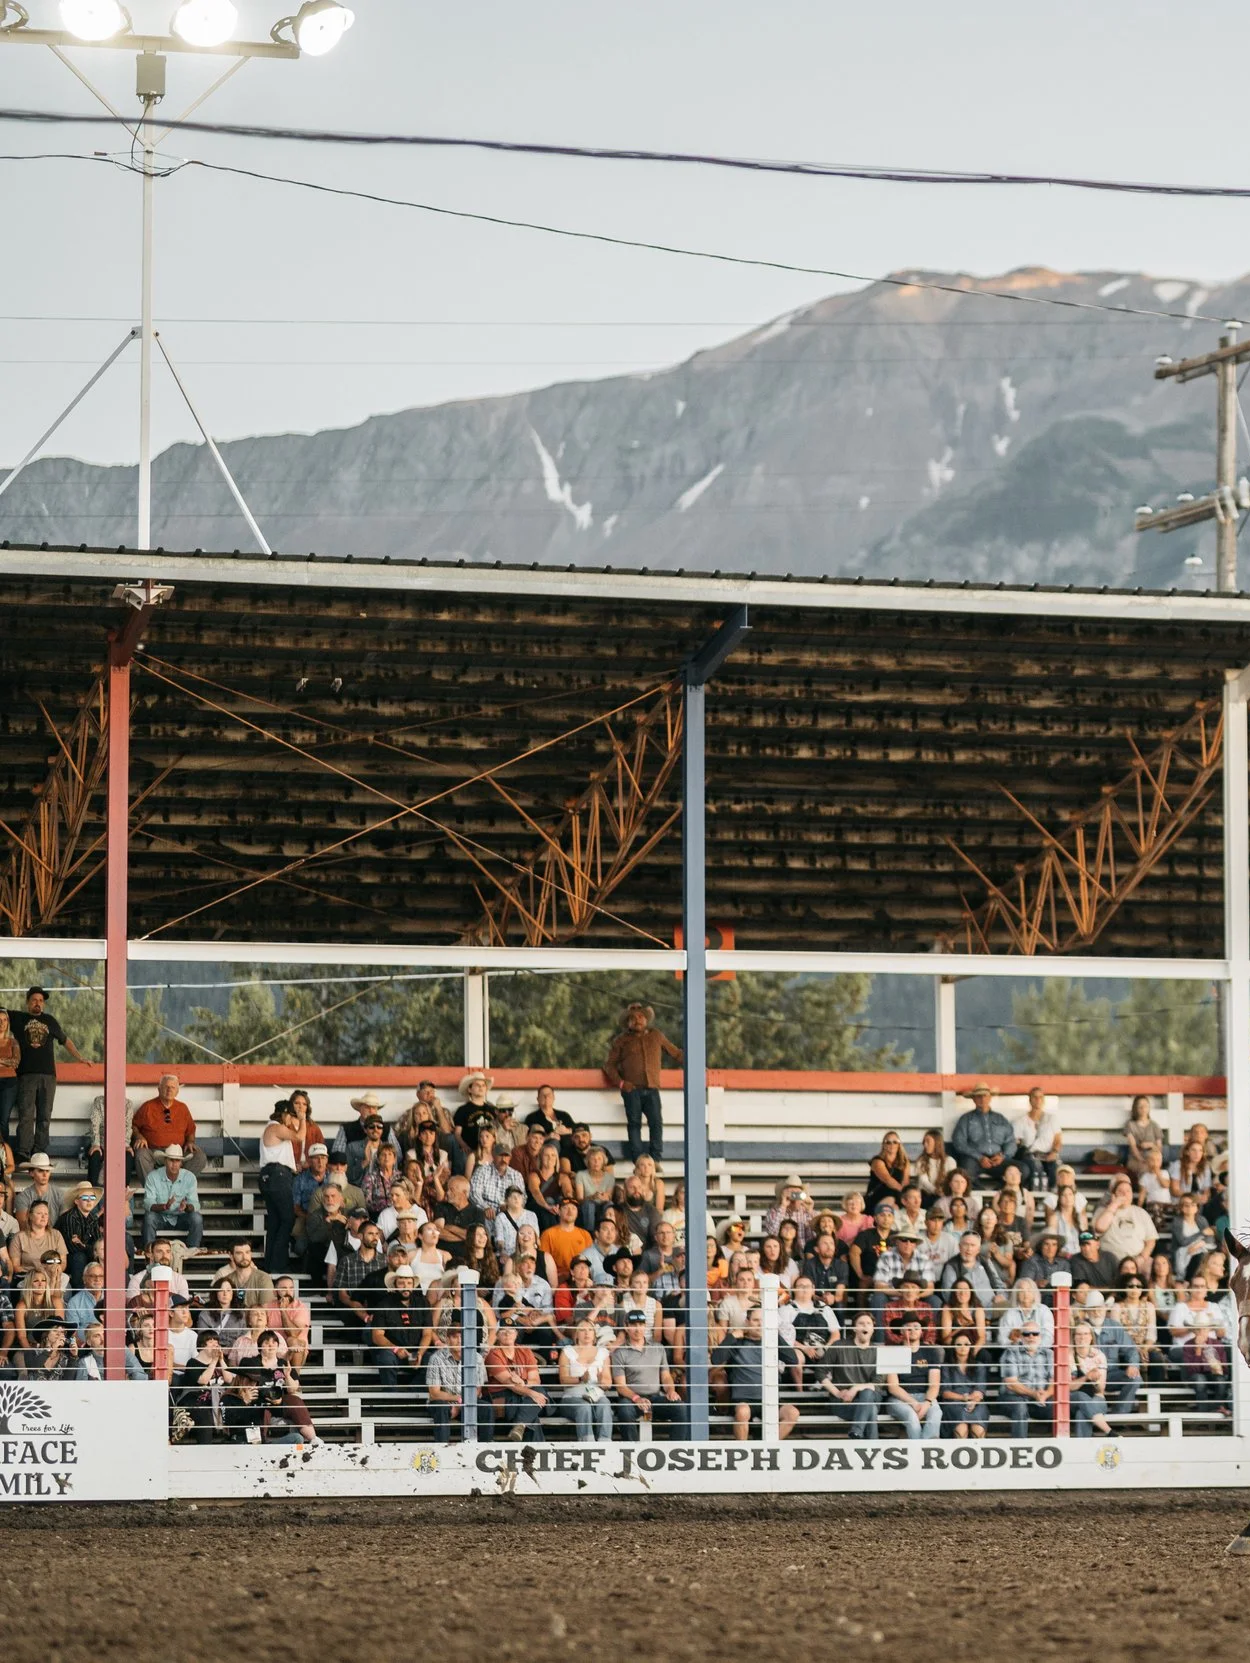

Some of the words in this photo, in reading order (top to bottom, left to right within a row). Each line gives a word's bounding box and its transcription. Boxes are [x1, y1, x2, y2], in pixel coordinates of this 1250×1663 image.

[21, 1423, 41, 1432] Trees
[43, 1423, 56, 1433] for
[59, 1423, 74, 1435] Life
[0, 1440, 78, 1465] FACE
[475, 1449, 606, 1473] CHIEF
[617, 1447, 780, 1473] JOSEPH
[792, 1448, 909, 1471] DAYS
[921, 1446, 1063, 1470] RODEO
